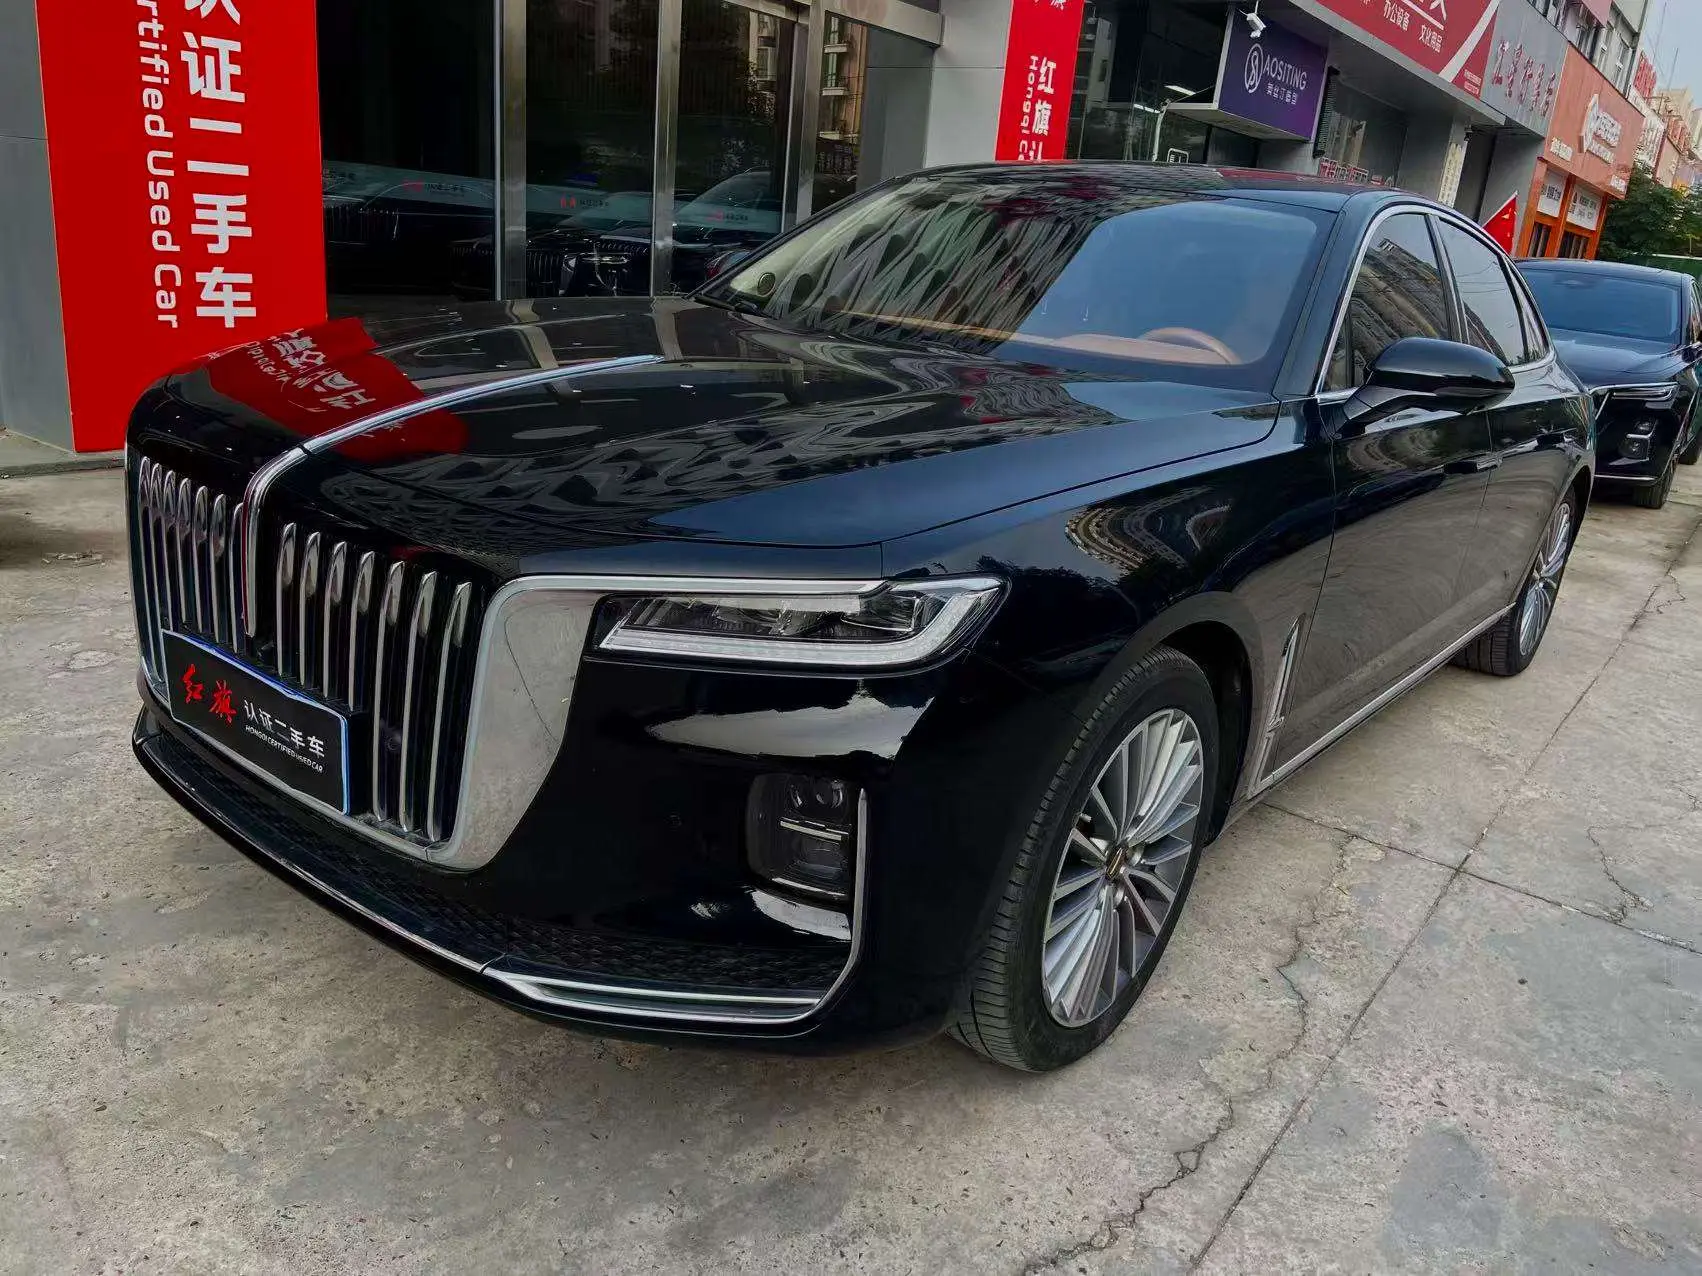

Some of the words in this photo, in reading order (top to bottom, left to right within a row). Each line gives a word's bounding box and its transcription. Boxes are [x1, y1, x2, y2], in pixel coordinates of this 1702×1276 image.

[1419, 25, 1443, 53] 文化用品
[1263, 54, 1308, 90] AOSITING
[147, 151, 181, 252] Used
[155, 264, 183, 329] Car
[244, 700, 325, 759] 认证二手车
